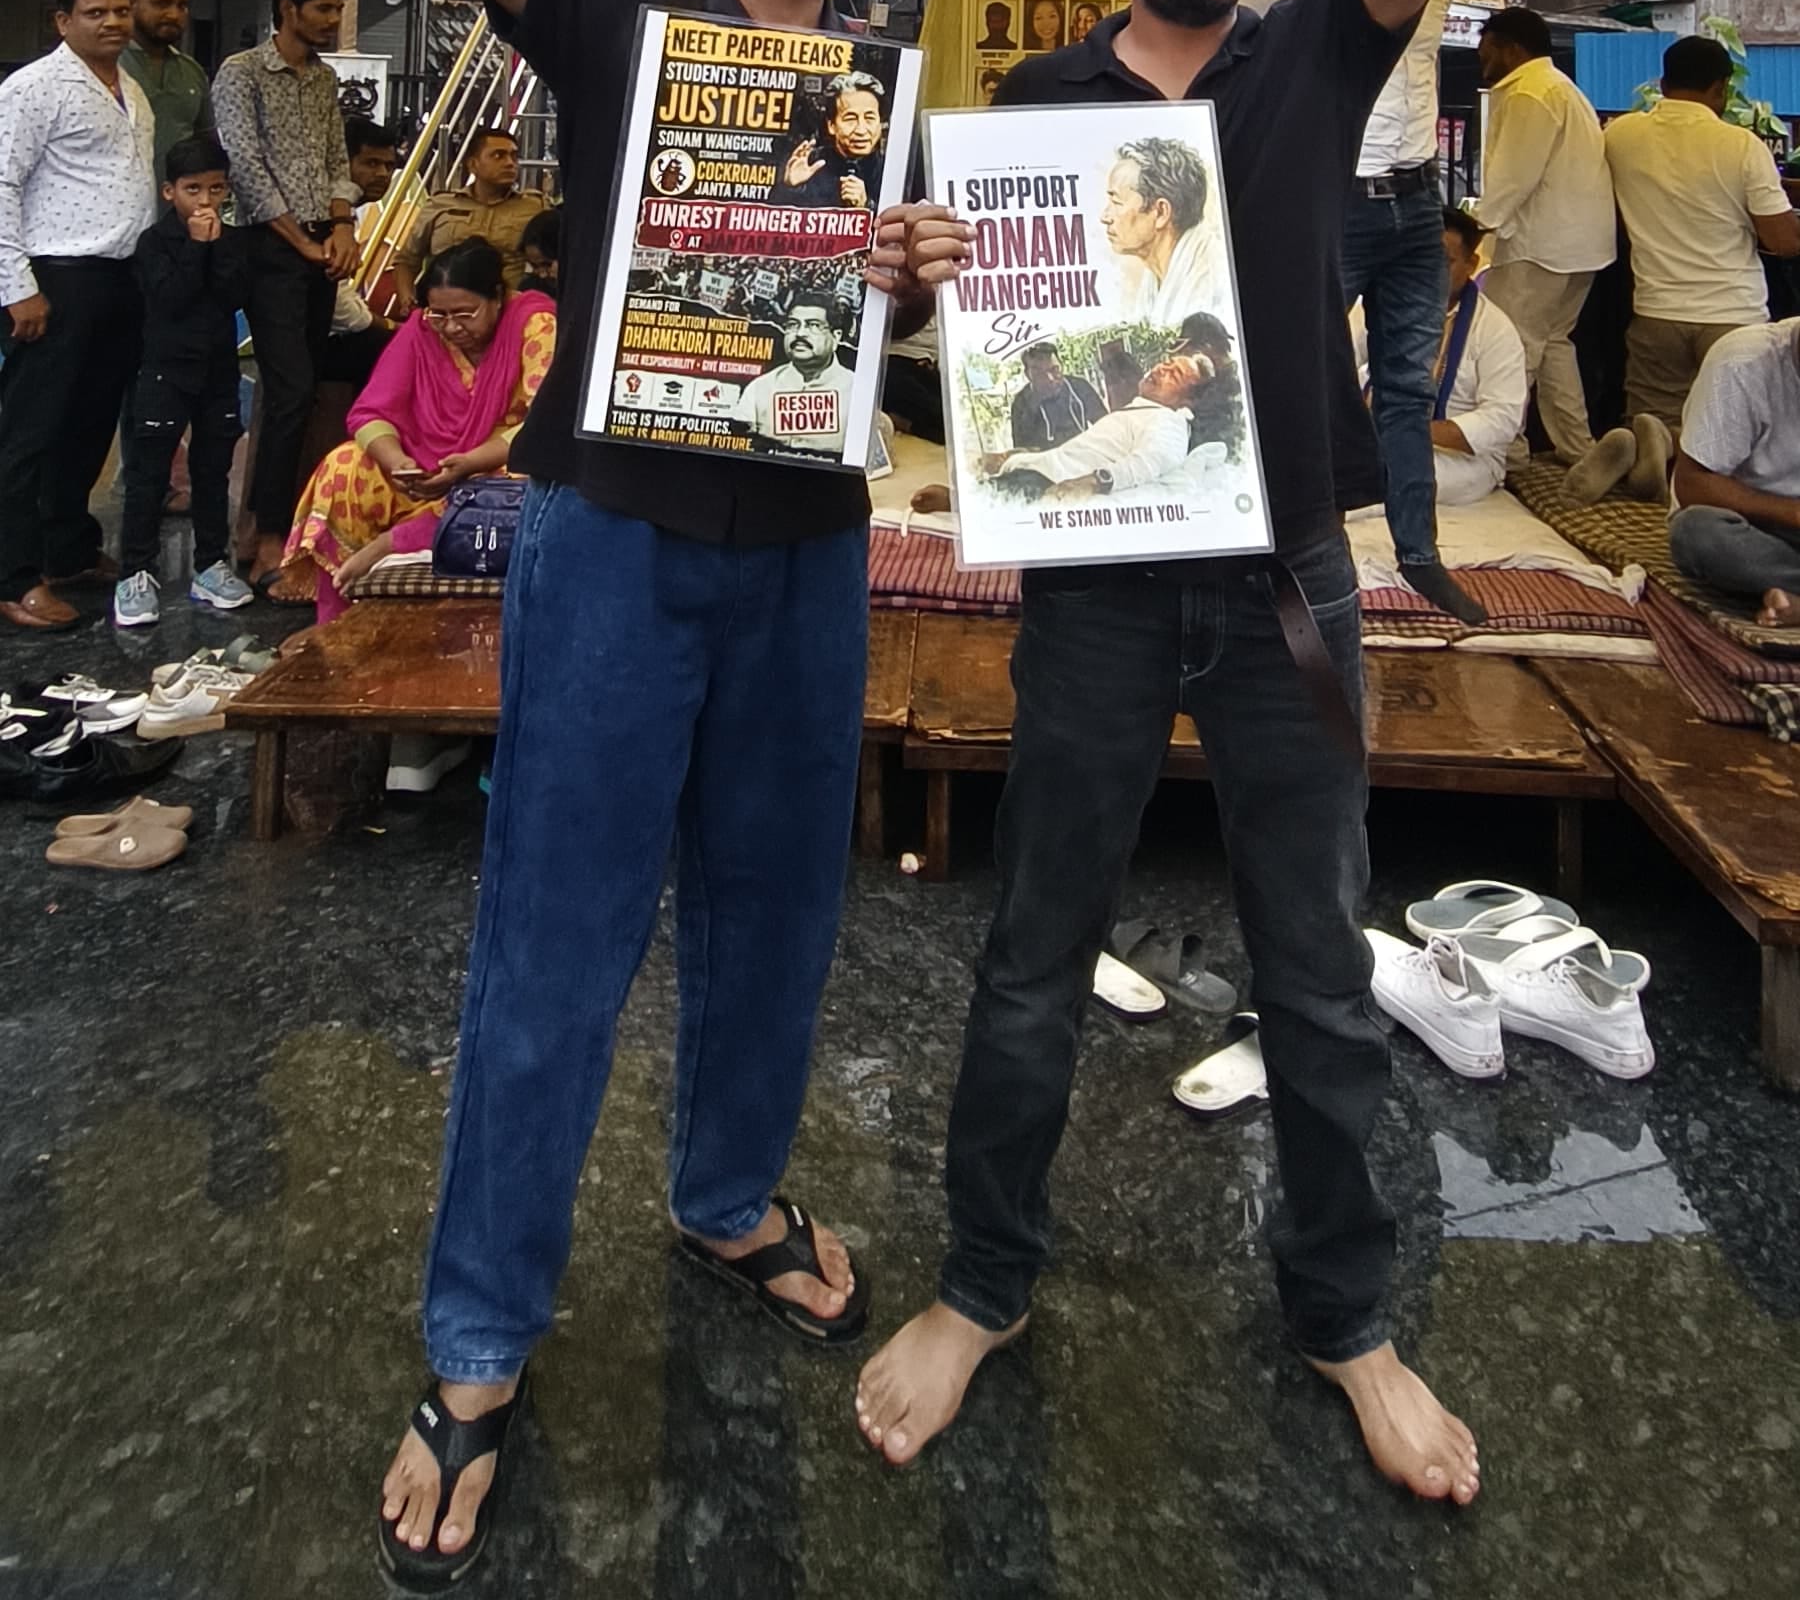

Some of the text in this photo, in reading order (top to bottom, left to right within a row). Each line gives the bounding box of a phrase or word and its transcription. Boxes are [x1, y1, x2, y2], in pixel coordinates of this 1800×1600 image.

[672, 28, 845, 69] NEET PAPER LEAKS
[665, 61, 797, 90] STUDENTS DEMAND
[659, 83, 794, 131] JUSTICE!
[658, 129, 774, 153] SONAM WANGCHUK
[697, 161, 777, 186] COCKROACH
[694, 181, 772, 200] JANTA PARTY
[947, 174, 1079, 212] I SUPPORT
[649, 203, 866, 237] UNREST HUNGER STRIKE
[688, 233, 835, 256] AT JANTAR MANTAR
[954, 269, 1102, 312] WANGCHUK
[628, 298, 681, 313] DEMAND FOR
[626, 311, 749, 333] UNION EDUCATION MINISTER
[984, 312, 1043, 355] Sir
[623, 325, 774, 361] DHARMENDRA PRADHAN
[622, 352, 641, 365] TAKE
[778, 395, 834, 411] RESIGN
[612, 411, 732, 435] THIS IS NOT POLITICS.
[780, 411, 834, 431] NOW!
[637, 426, 648, 439] IS
[651, 429, 687, 443] ABOUT
[688, 432, 711, 446] OUR
[712, 434, 755, 452] FUTURE.
[1039, 503, 1190, 530] WE STAND WITH YOU.
